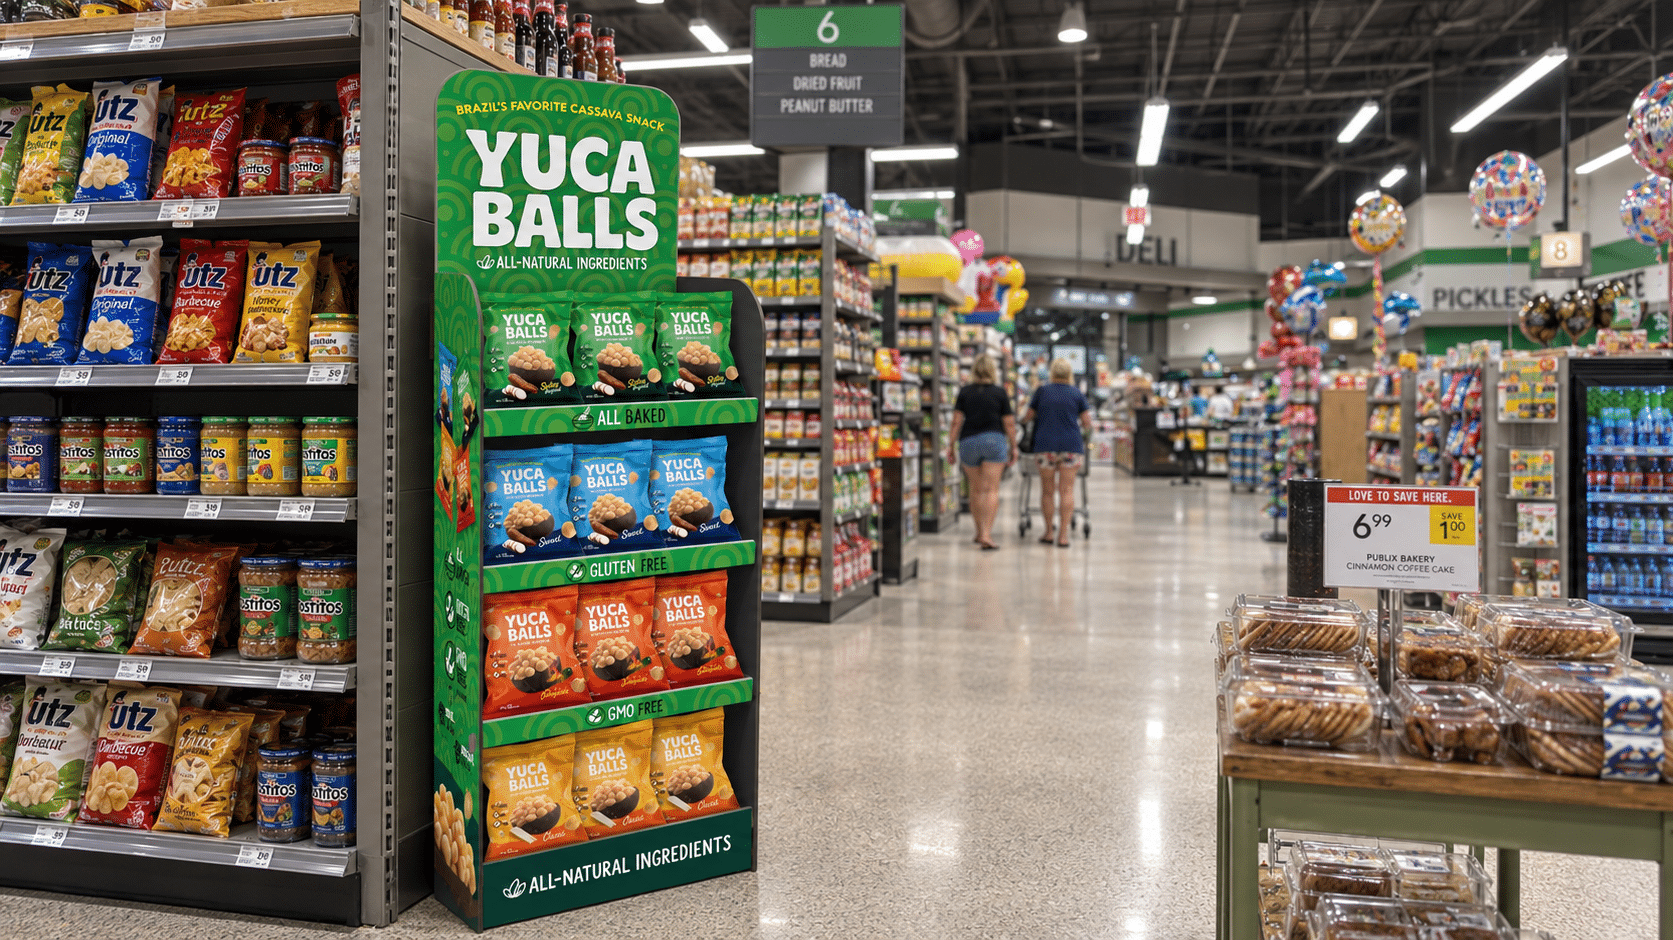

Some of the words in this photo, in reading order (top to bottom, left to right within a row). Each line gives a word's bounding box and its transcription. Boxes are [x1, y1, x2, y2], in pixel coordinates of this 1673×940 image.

[817, 10, 840, 44] 6
[809, 53, 847, 68] BREAD
[793, 76, 827, 91] DRIED
[829, 76, 863, 91] FRUIT
[780, 98, 826, 114] PEANUT
[828, 98, 874, 114] BUTTER
[456, 101, 508, 116] BRAZIL'S
[510, 101, 567, 113] FAVORITE
[570, 104, 623, 121] CASSAVA
[626, 113, 666, 132] SNACK
[465, 129, 656, 195] YUCA
[472, 191, 659, 251] BALLS
[1554, 240, 1567, 260] 8
[497, 255, 573, 270] ALL-NATURAL
[576, 257, 648, 270] INGREDIENTS
[1433, 286, 1533, 308] PICKLES
[502, 313, 547, 327] YUCA
[591, 312, 633, 325] YUCA
[671, 311, 710, 324] YUCA
[505, 326, 548, 339] BALLS
[594, 324, 634, 337] BALLS
[674, 323, 712, 336] BALLS
[597, 409, 621, 427] ALL
[625, 407, 666, 425] BAKED
[584, 462, 626, 476] YUCA
[662, 458, 703, 471] YUCA
[501, 467, 545, 482] YUCA
[587, 474, 628, 488] BALLS
[665, 469, 705, 483] BALLS
[503, 480, 547, 495] BALLS
[1348, 490, 1373, 501] LOVE
[1377, 490, 1390, 501] TO
[1393, 491, 1419, 502] SAVE
[1422, 492, 1452, 503] HERE.
[1441, 512, 1463, 521] SAVE
[1366, 553, 1398, 562] PUBLIX
[1400, 554, 1436, 563] BAKERY
[589, 559, 636, 579] GLUTEN
[640, 556, 667, 573] FREE
[1346, 562, 1395, 571] CINNAMON
[1397, 564, 1430, 573] COFFEE
[1432, 565, 1455, 574] CAKE
[662, 594, 703, 609] YUCA
[585, 602, 628, 619] YUCA
[665, 605, 706, 622] BALLS
[505, 611, 550, 628] YUCA
[588, 615, 631, 631] BALLS
[508, 624, 552, 642] BALLS
[608, 703, 635, 721] GMO
[637, 699, 664, 717] FREE
[661, 733, 700, 749] YUCA
[586, 746, 626, 764] YUCA
[664, 744, 703, 762] BALLS
[505, 761, 548, 779] YUCA
[588, 758, 628, 777] BALLS
[509, 774, 550, 792] BALLS
[528, 857, 631, 894] ALL-NATURAL
[635, 834, 732, 871] INGREDIENTS
